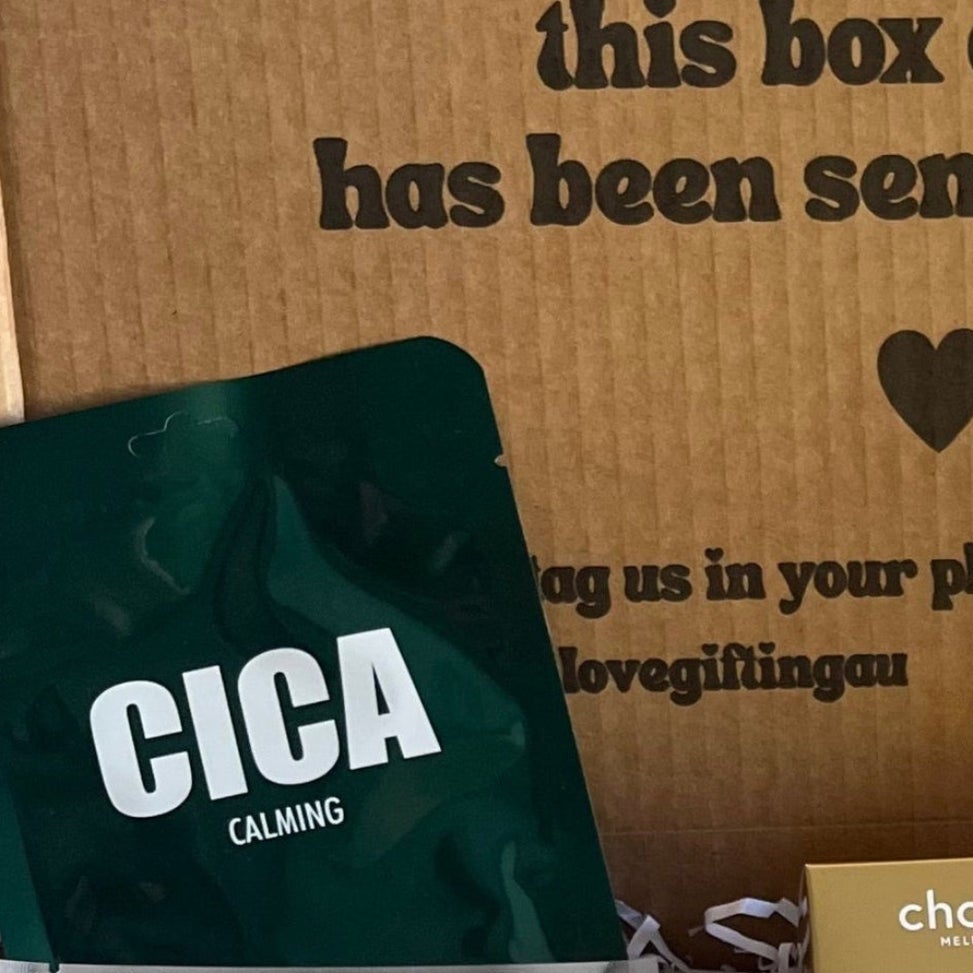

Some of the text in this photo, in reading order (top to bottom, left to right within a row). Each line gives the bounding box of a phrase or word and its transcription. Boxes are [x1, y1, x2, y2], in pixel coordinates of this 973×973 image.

[535, 0, 736, 90] this
[761, 0, 944, 86] box
[313, 137, 505, 229] has
[526, 133, 781, 225] been
[532, 556, 610, 619] ag
[624, 564, 692, 601] us
[705, 548, 766, 600] in
[778, 559, 917, 615] your
[559, 641, 908, 706] lovegiftingau
[90, 628, 442, 818] CICA
[228, 796, 344, 845] CALMING
